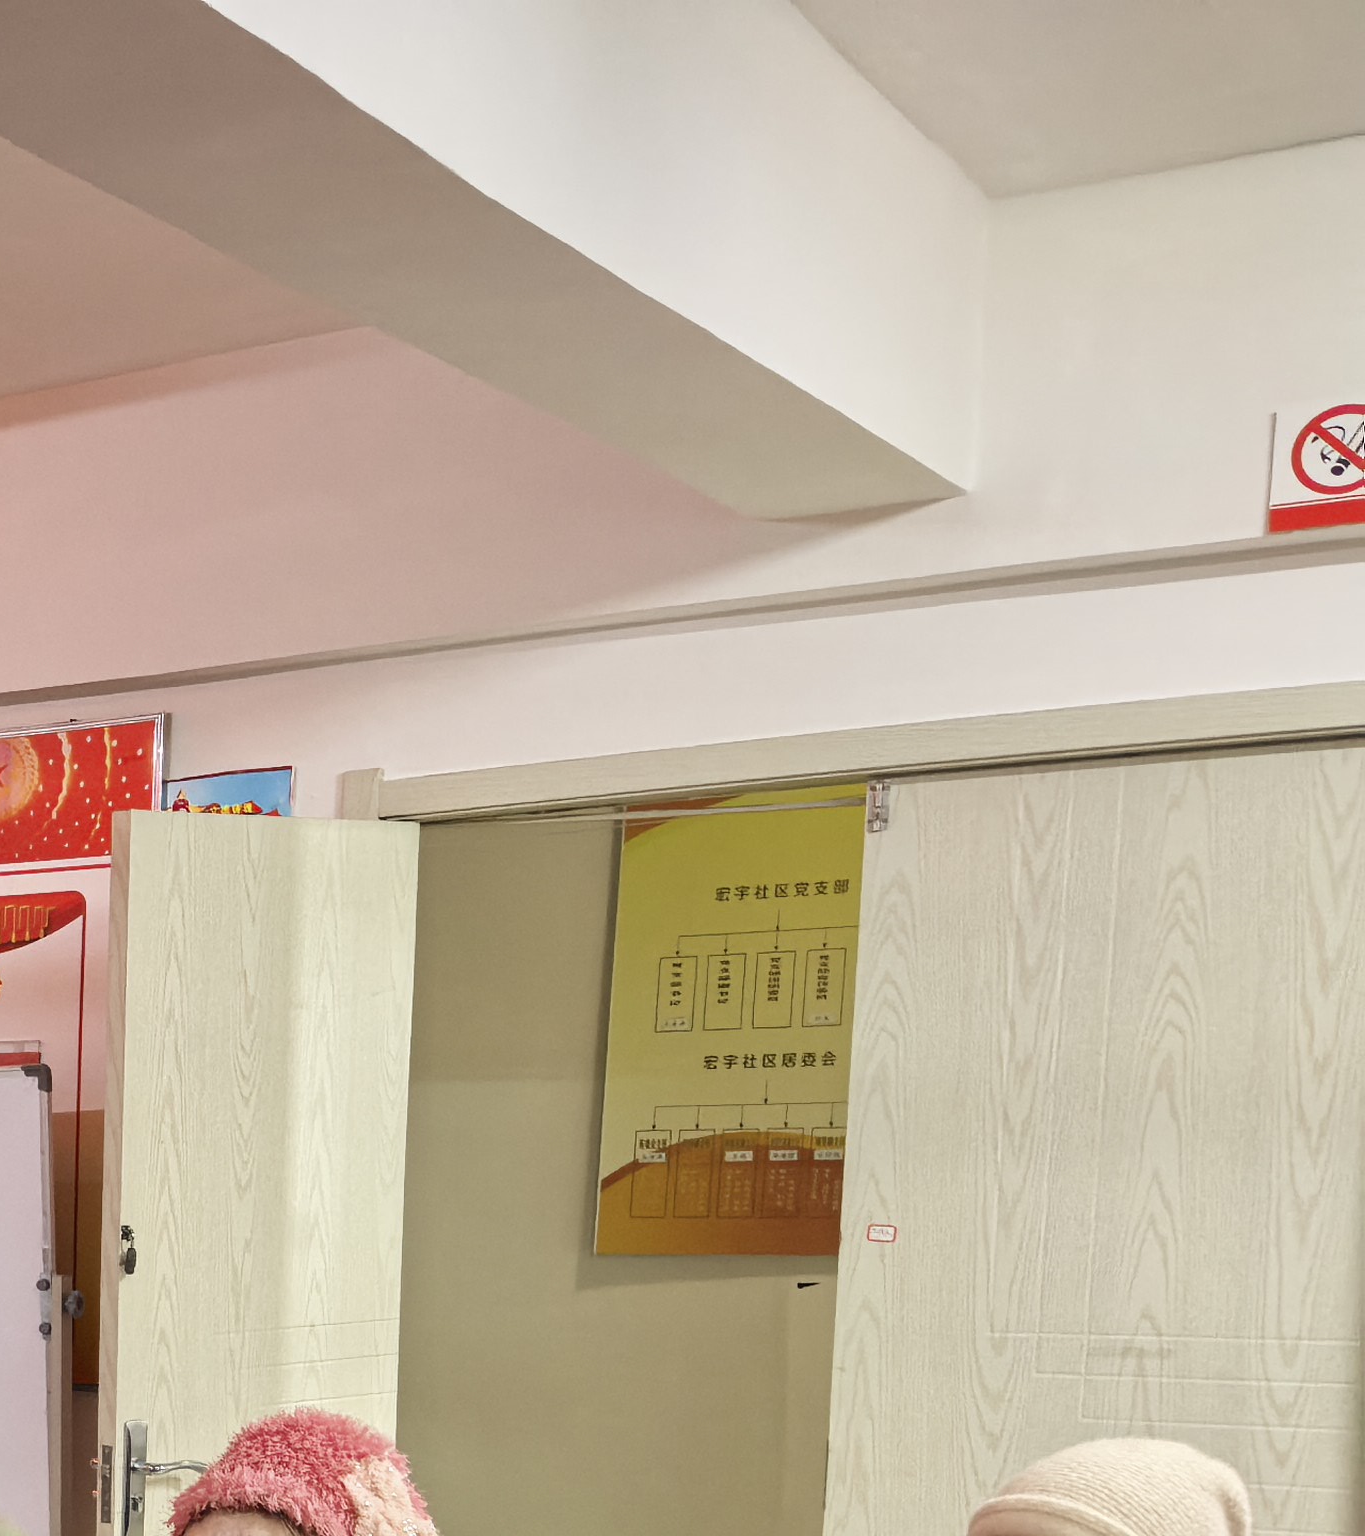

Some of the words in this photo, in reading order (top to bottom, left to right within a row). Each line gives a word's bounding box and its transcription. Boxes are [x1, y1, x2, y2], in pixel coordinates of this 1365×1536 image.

[715, 878, 850, 902] 宏宇社区党支部
[703, 1051, 837, 1070] 宏宇社区居委会
